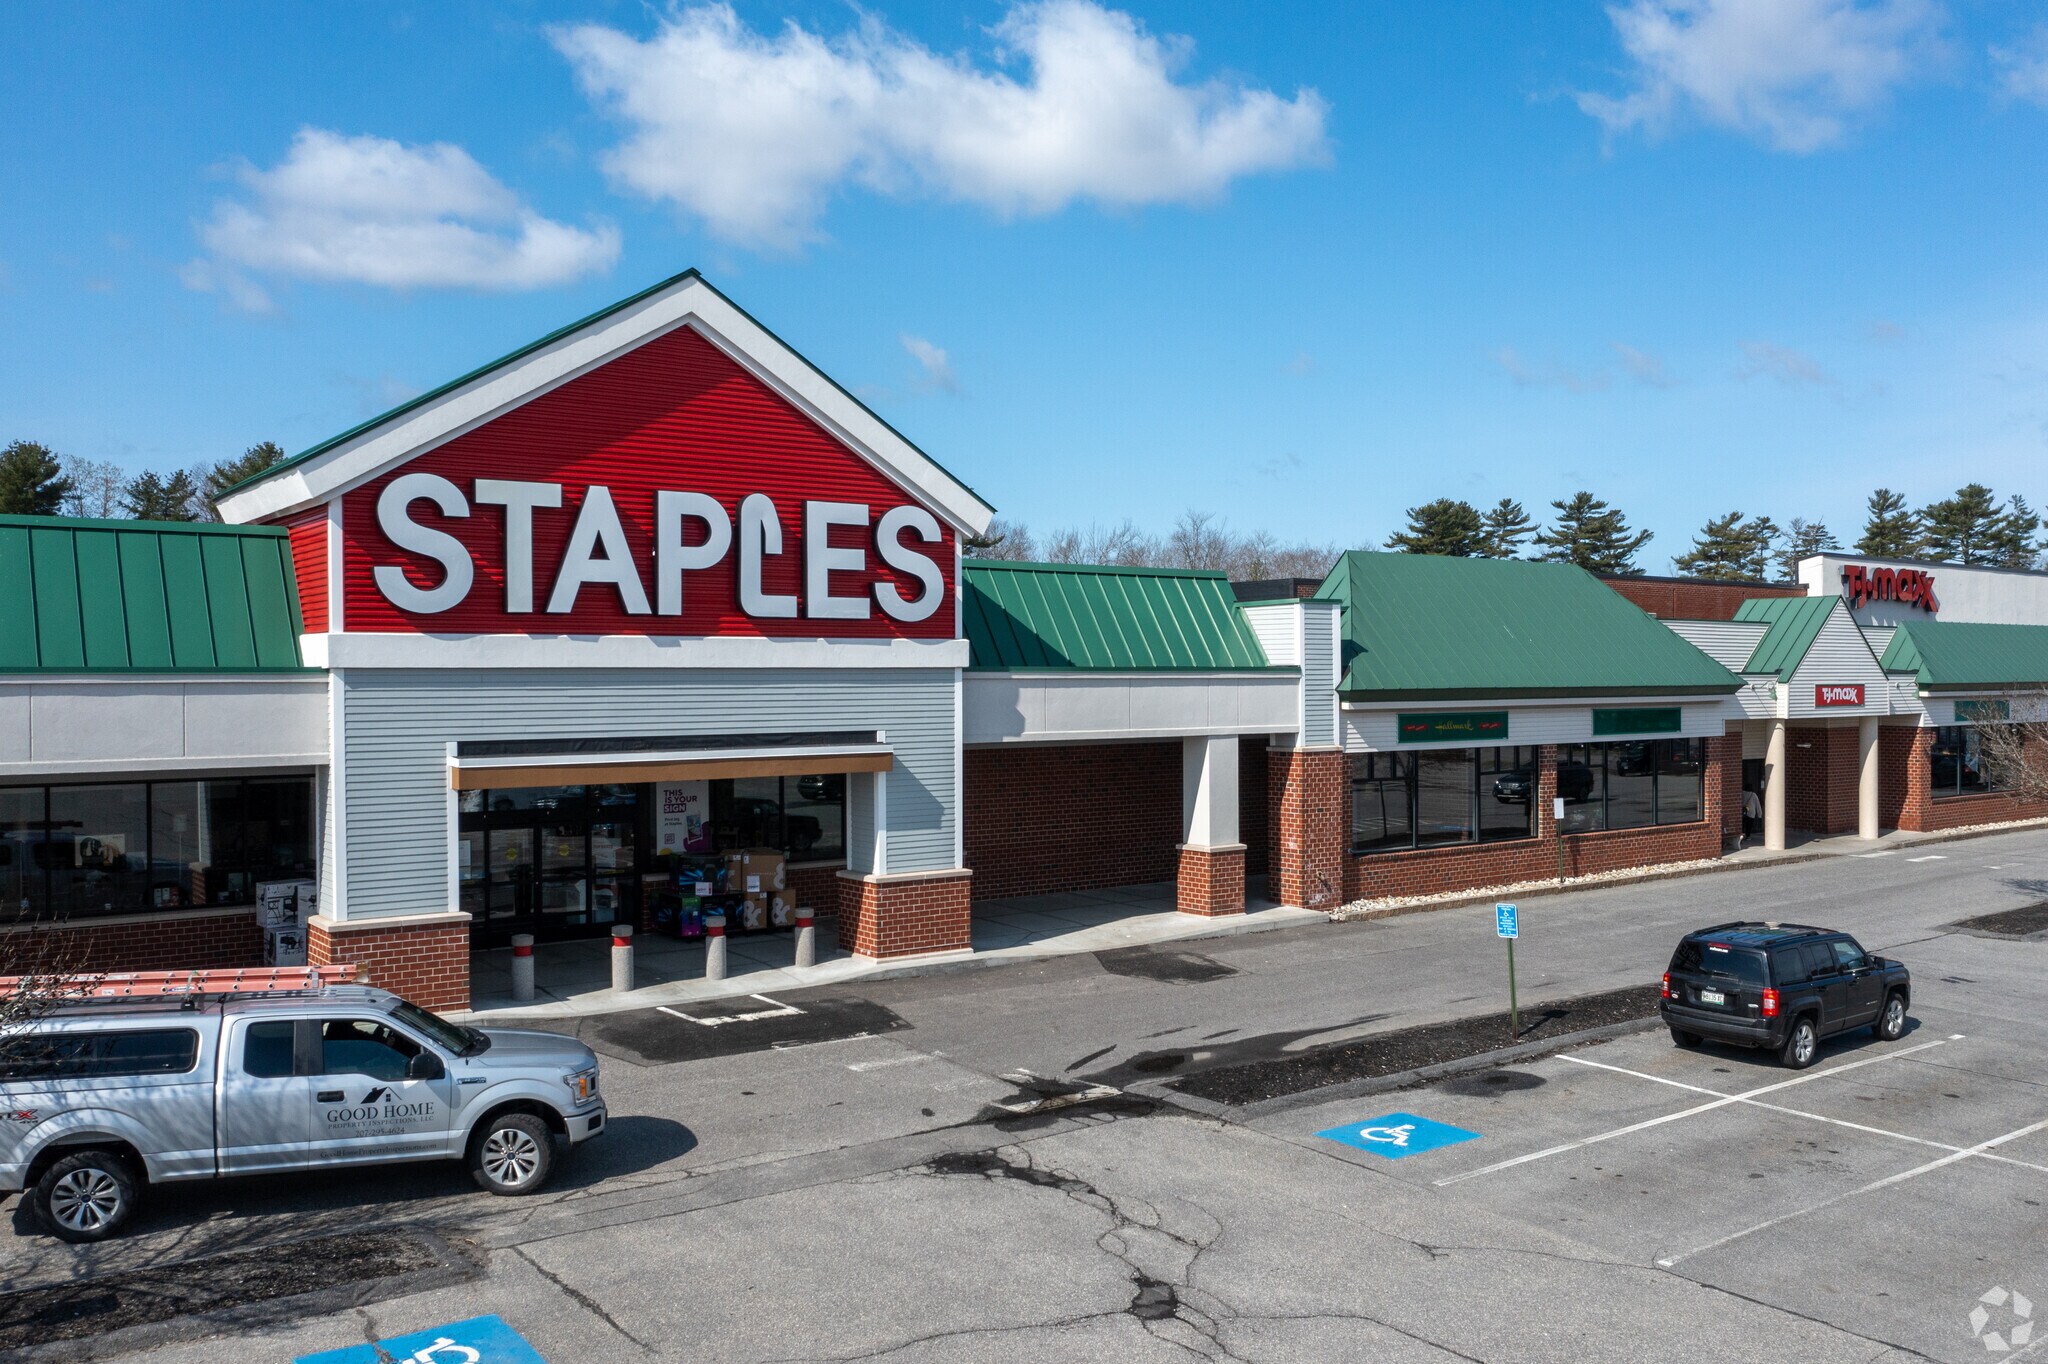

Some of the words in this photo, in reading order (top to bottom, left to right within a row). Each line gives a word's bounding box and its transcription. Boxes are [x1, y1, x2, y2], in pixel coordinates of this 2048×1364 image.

[372, 472, 945, 623] STAPLES
[664, 789, 683, 797] THIS
[664, 796, 673, 804] IS
[674, 795, 698, 803] YOUR
[664, 804, 686, 813] SIGN
[327, 1106, 379, 1122] GOOD
[384, 1102, 435, 1118] HOME
